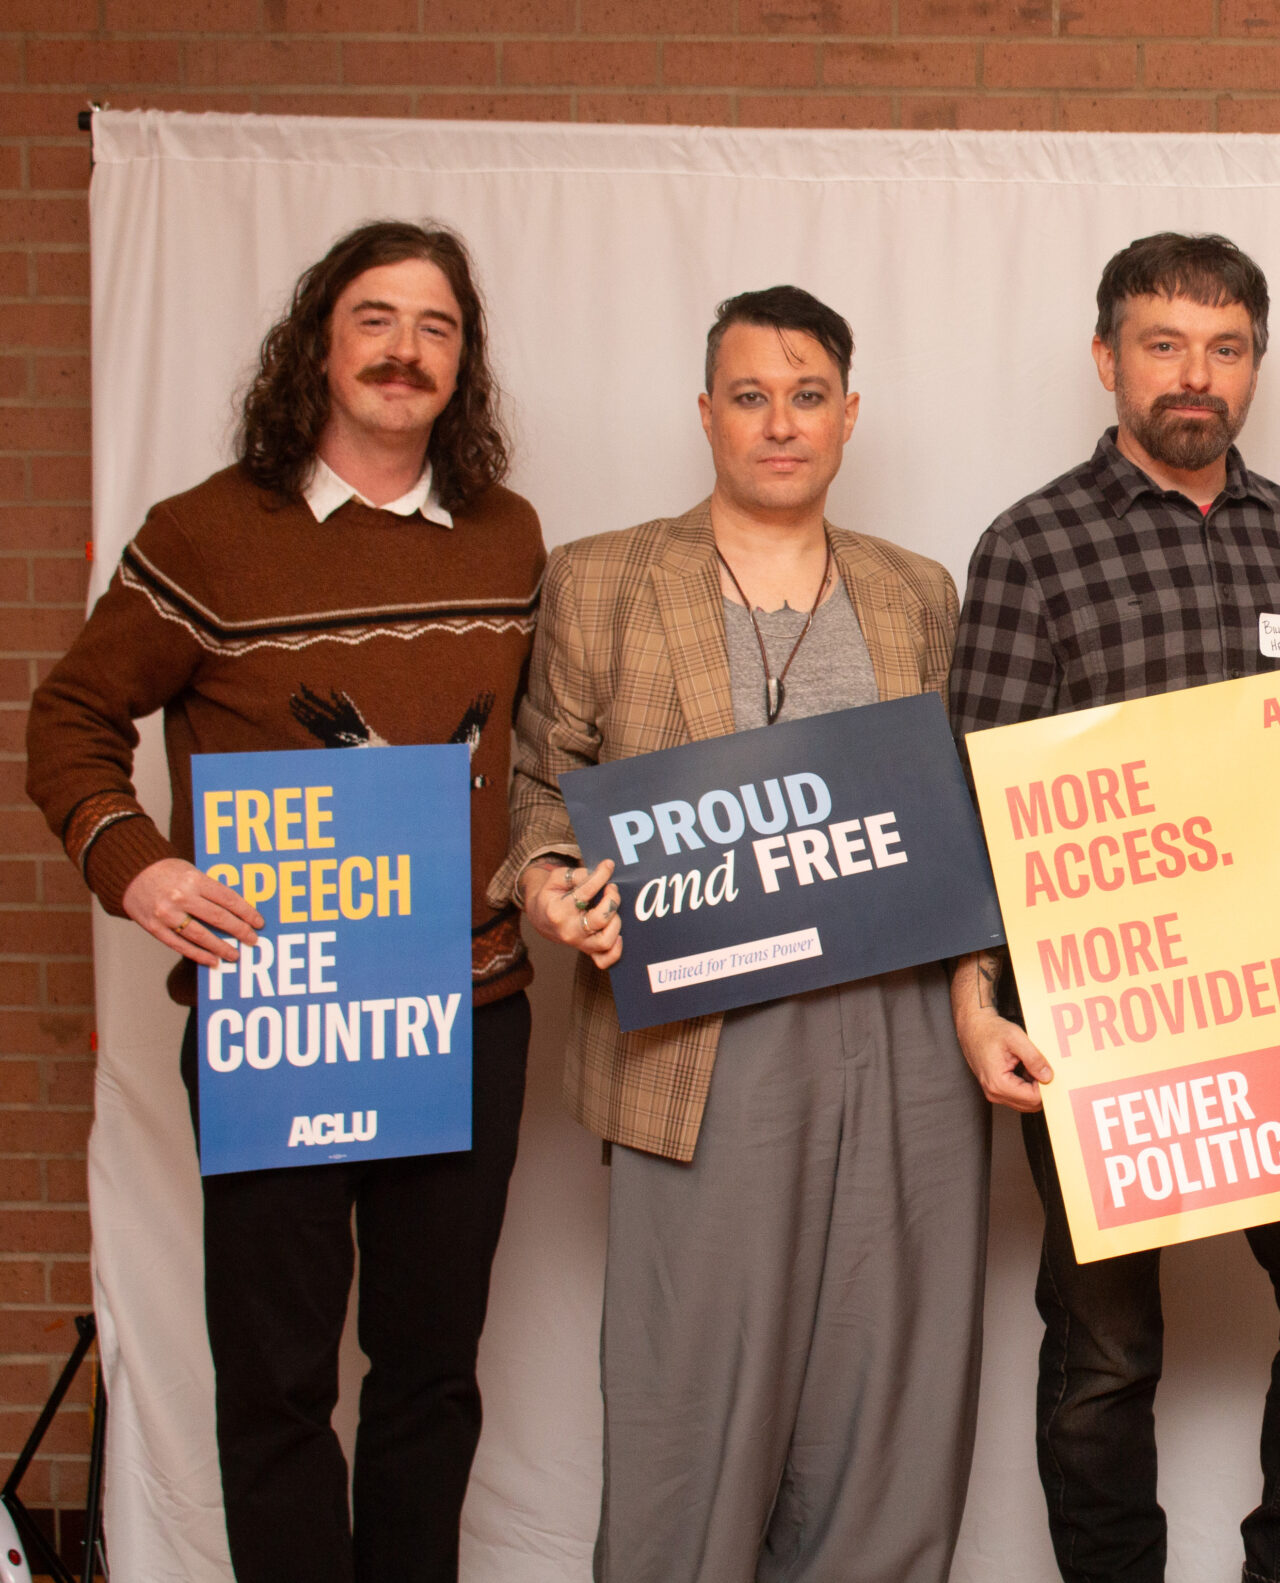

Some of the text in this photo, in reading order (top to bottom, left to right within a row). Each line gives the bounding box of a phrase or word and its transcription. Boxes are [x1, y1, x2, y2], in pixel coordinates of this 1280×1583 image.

[203, 786, 336, 855] FREE
[609, 772, 833, 866] PROUD
[1005, 760, 1155, 840] MORE
[635, 811, 908, 921] and FREE
[1024, 816, 1234, 907] ACCESS.
[208, 931, 337, 1000] FREE
[657, 937, 814, 985] United for Trans Power
[1036, 912, 1188, 993] MORE
[207, 993, 462, 1073] COUNTRY
[287, 1110, 378, 1147] ACLU
[1092, 1070, 1255, 1150] FEWER
